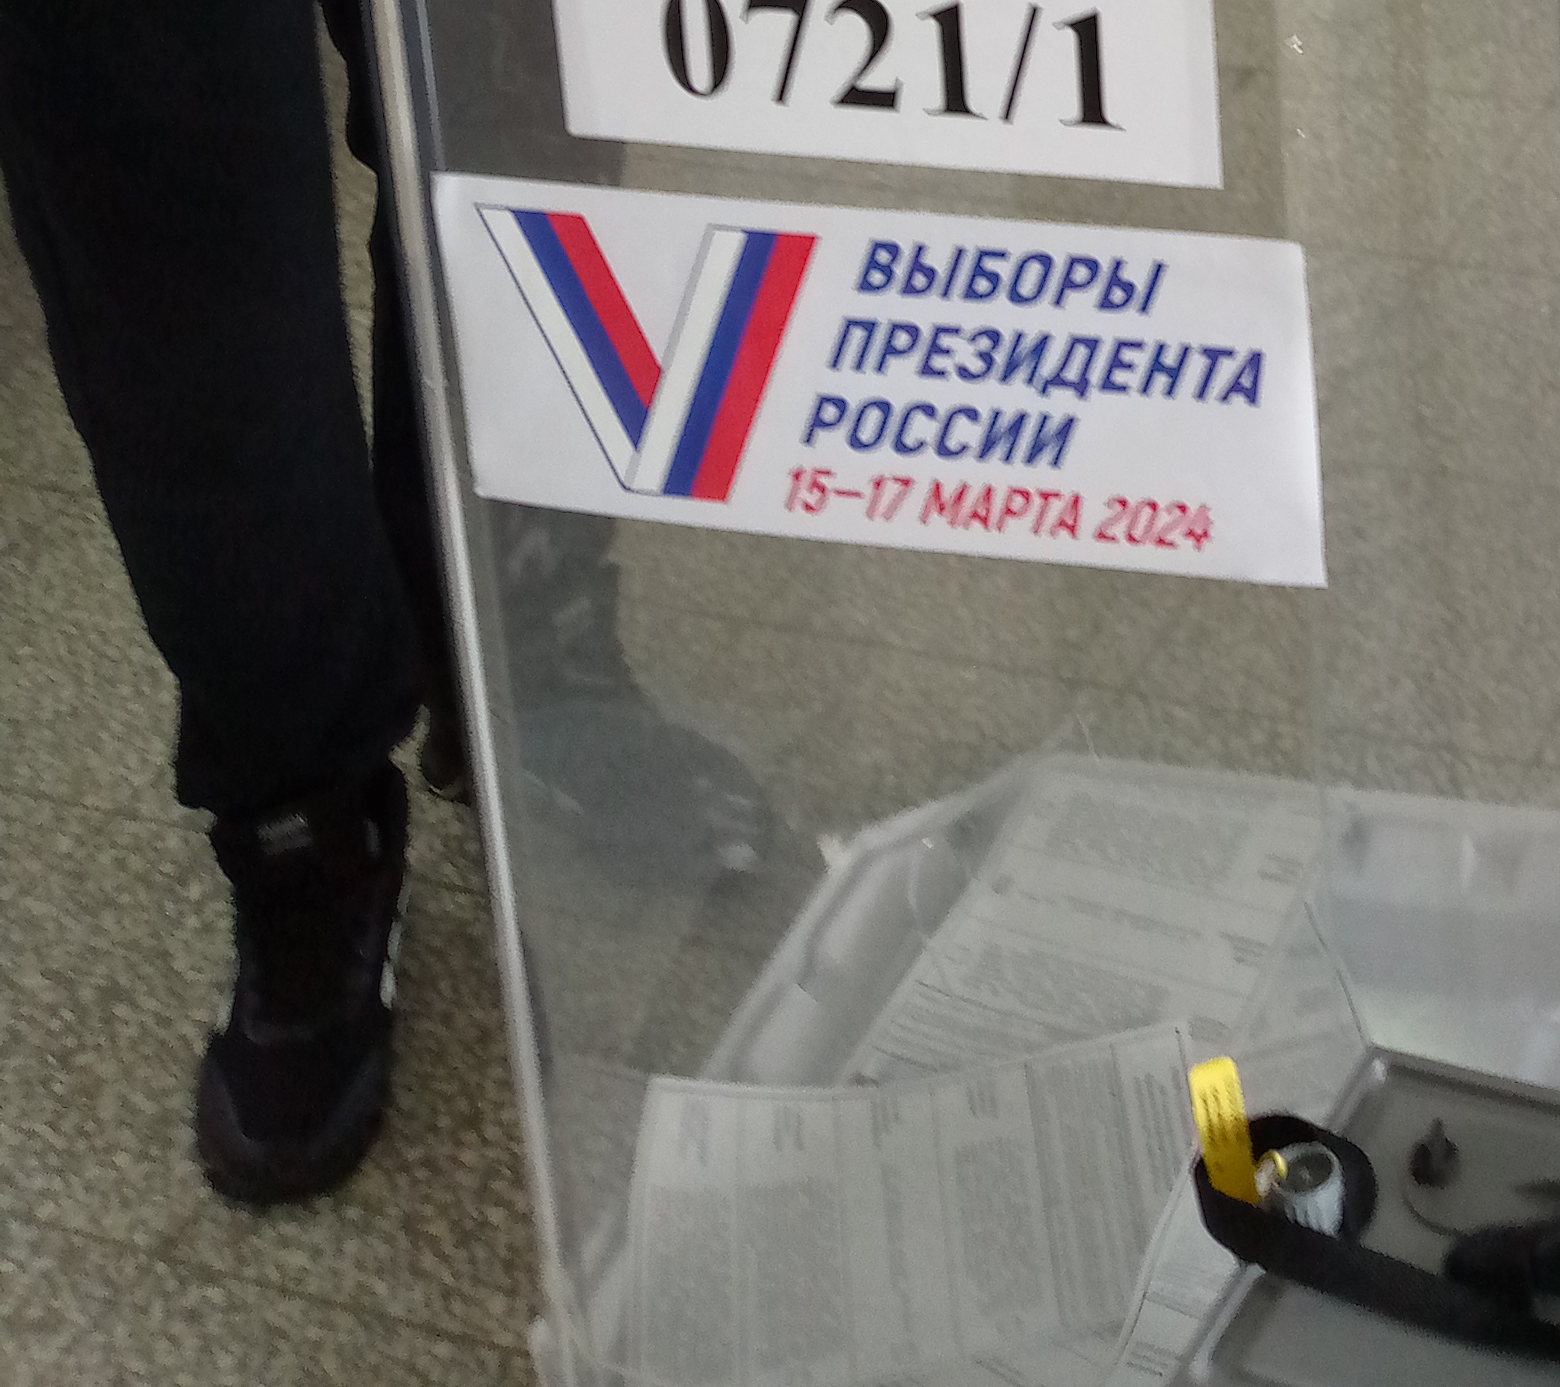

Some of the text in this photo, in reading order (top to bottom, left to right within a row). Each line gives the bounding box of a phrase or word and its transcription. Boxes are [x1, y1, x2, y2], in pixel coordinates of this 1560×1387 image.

[857, 238, 1169, 316] ВЫБОРЫ
[827, 314, 1265, 408] ПРЕЗИДЕНТА
[800, 393, 1079, 470] РОССИИ
[920, 479, 1082, 540] МАРТА
[1094, 496, 1215, 553] 2024
